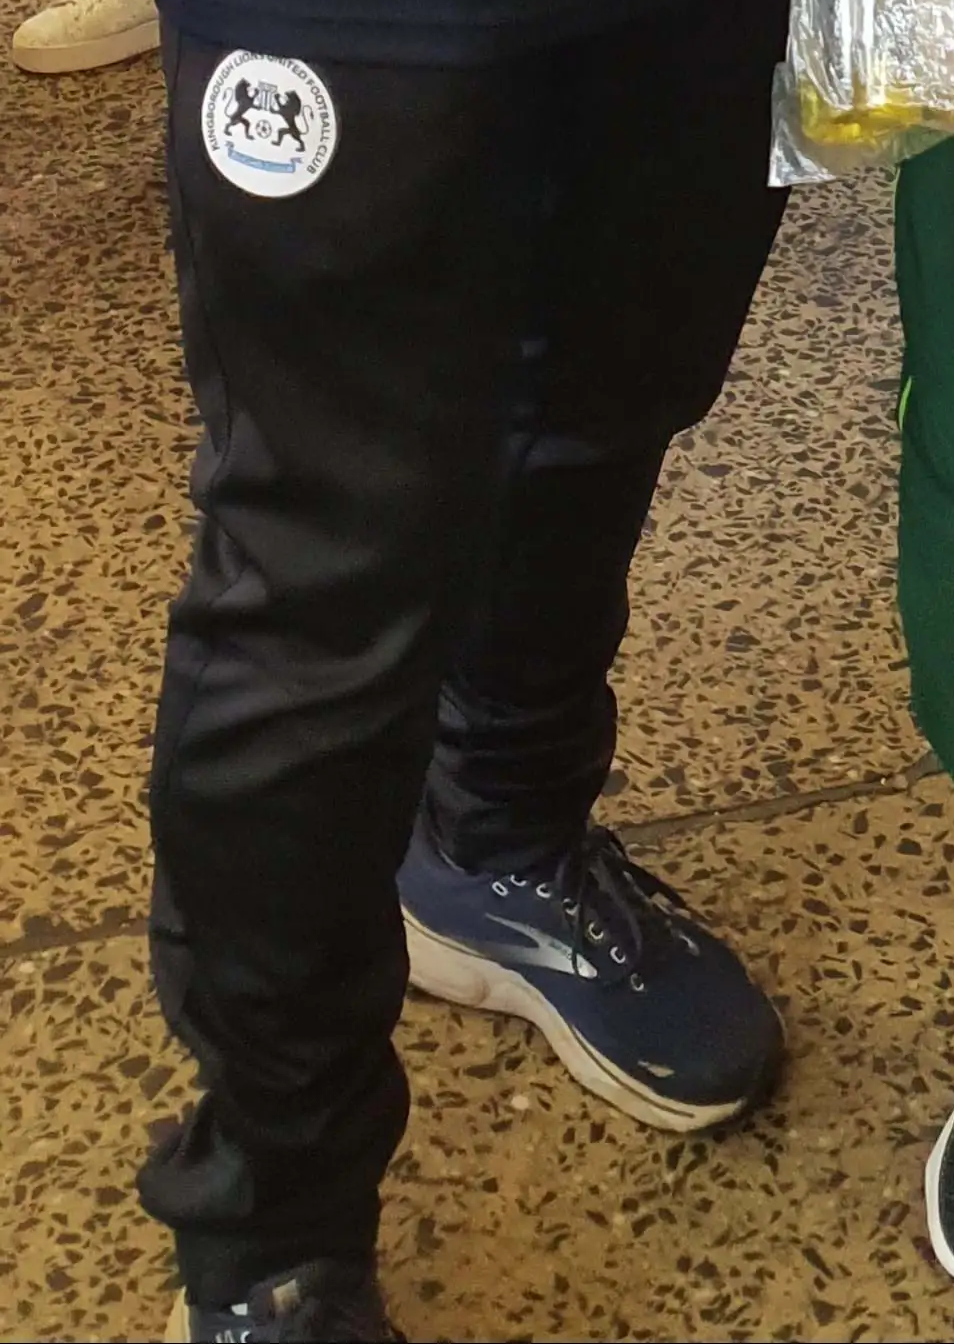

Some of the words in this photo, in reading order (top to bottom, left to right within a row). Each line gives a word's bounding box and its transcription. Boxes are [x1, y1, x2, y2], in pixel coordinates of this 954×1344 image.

[205, 62, 235, 152] KINGBOROUGH
[305, 77, 332, 142] FOOTBALL
[306, 145, 328, 174] CLUB
